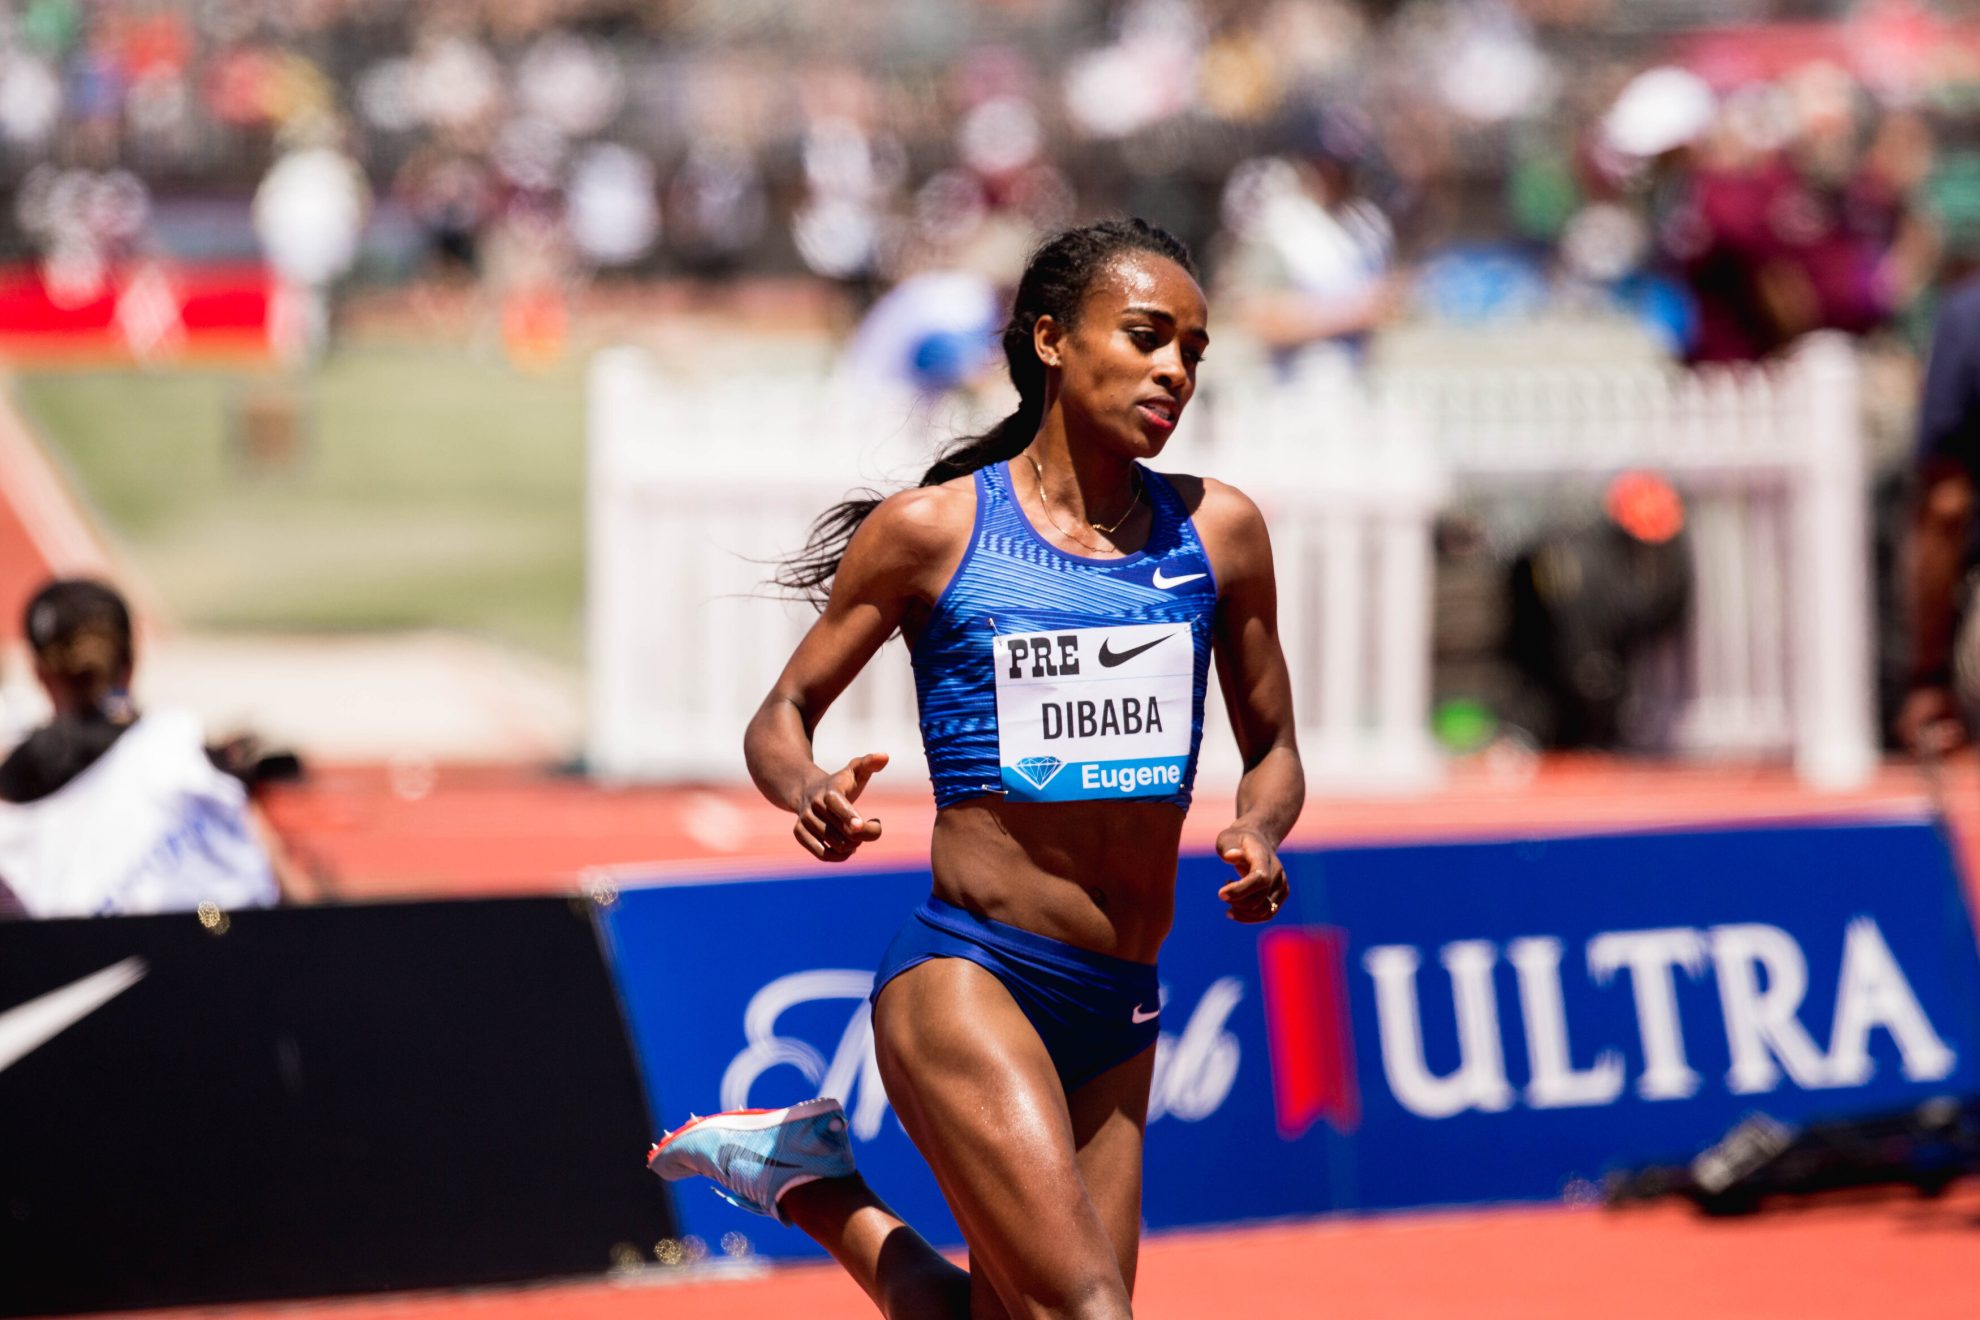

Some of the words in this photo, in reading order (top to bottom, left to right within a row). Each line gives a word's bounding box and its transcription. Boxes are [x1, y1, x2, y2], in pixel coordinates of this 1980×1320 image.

[1007, 635, 1080, 679] PRE
[1041, 696, 1163, 740] DIBABA
[1081, 764, 1180, 792] Eugene
[1363, 916, 1957, 1119] ULTRA
